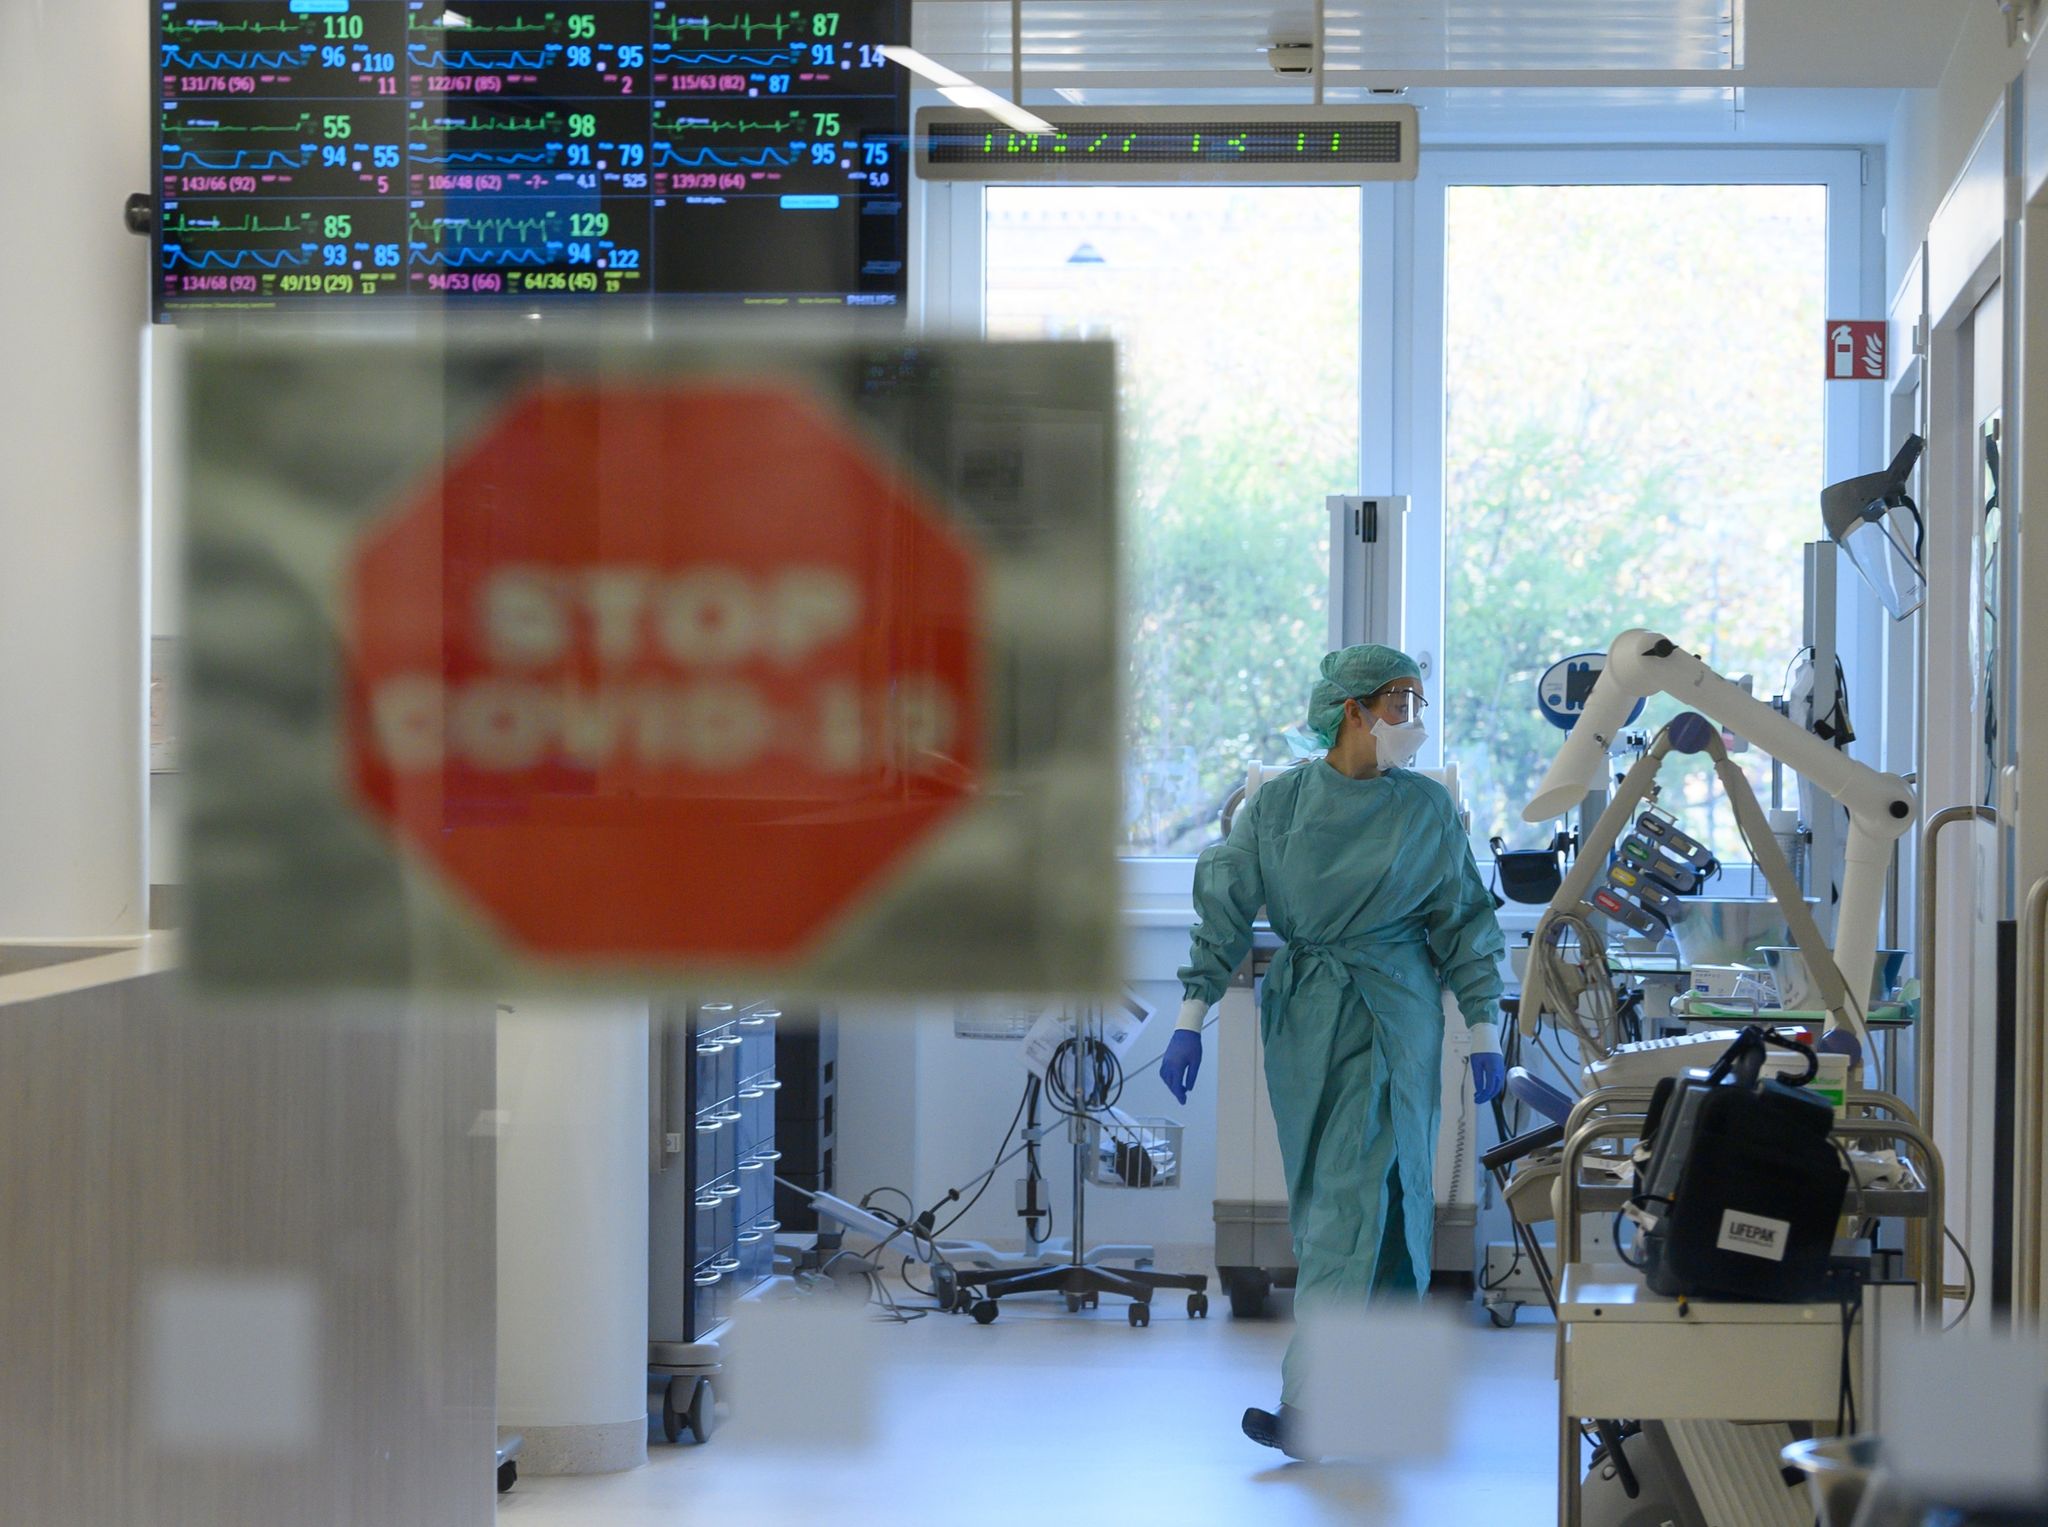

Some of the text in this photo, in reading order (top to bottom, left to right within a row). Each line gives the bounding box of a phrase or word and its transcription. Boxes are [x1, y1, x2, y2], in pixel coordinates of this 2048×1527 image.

[323, 15, 363, 39] 110
[567, 14, 596, 39] 95
[812, 12, 840, 37] 87
[320, 45, 346, 68] 96
[362, 52, 395, 73] 110
[566, 45, 592, 68] 98
[617, 44, 644, 69] 95
[810, 43, 836, 66] 91
[858, 44, 886, 68] 14
[181, 75, 227, 92] 131/76
[378, 76, 397, 95] 11
[426, 75, 473, 93] 122/67
[621, 75, 633, 94] 2
[672, 74, 717, 91] 115/63
[768, 73, 791, 94] 87
[323, 115, 352, 139] 55
[568, 113, 596, 138] 98
[812, 112, 840, 137] 75
[321, 144, 347, 168] 94
[373, 144, 400, 168] 55
[566, 143, 591, 167] 91
[617, 143, 645, 167] 79
[810, 142, 836, 165] 95
[862, 141, 889, 166] 75
[182, 176, 228, 192] 143/66
[228, 175, 257, 193] (92)
[377, 175, 389, 194] 5
[428, 174, 474, 190] 106/48
[672, 173, 718, 189] 139/39
[718, 173, 746, 190] (64)
[324, 214, 352, 239] 85
[568, 212, 609, 237] 129
[322, 243, 347, 267] 93
[373, 243, 401, 267] 85
[566, 241, 593, 265] 94
[606, 246, 640, 269] 122
[182, 275, 257, 292] 134/68 (92)
[279, 274, 353, 294] 49/19 (29)
[361, 278, 376, 295] 13
[427, 273, 502, 293] 94/53 (66)
[524, 272, 598, 292] 64/36 (45)
[606, 279, 620, 293] 19
[480, 568, 860, 668] STOP
[1729, 1221, 1776, 1243] LIFEPAK
